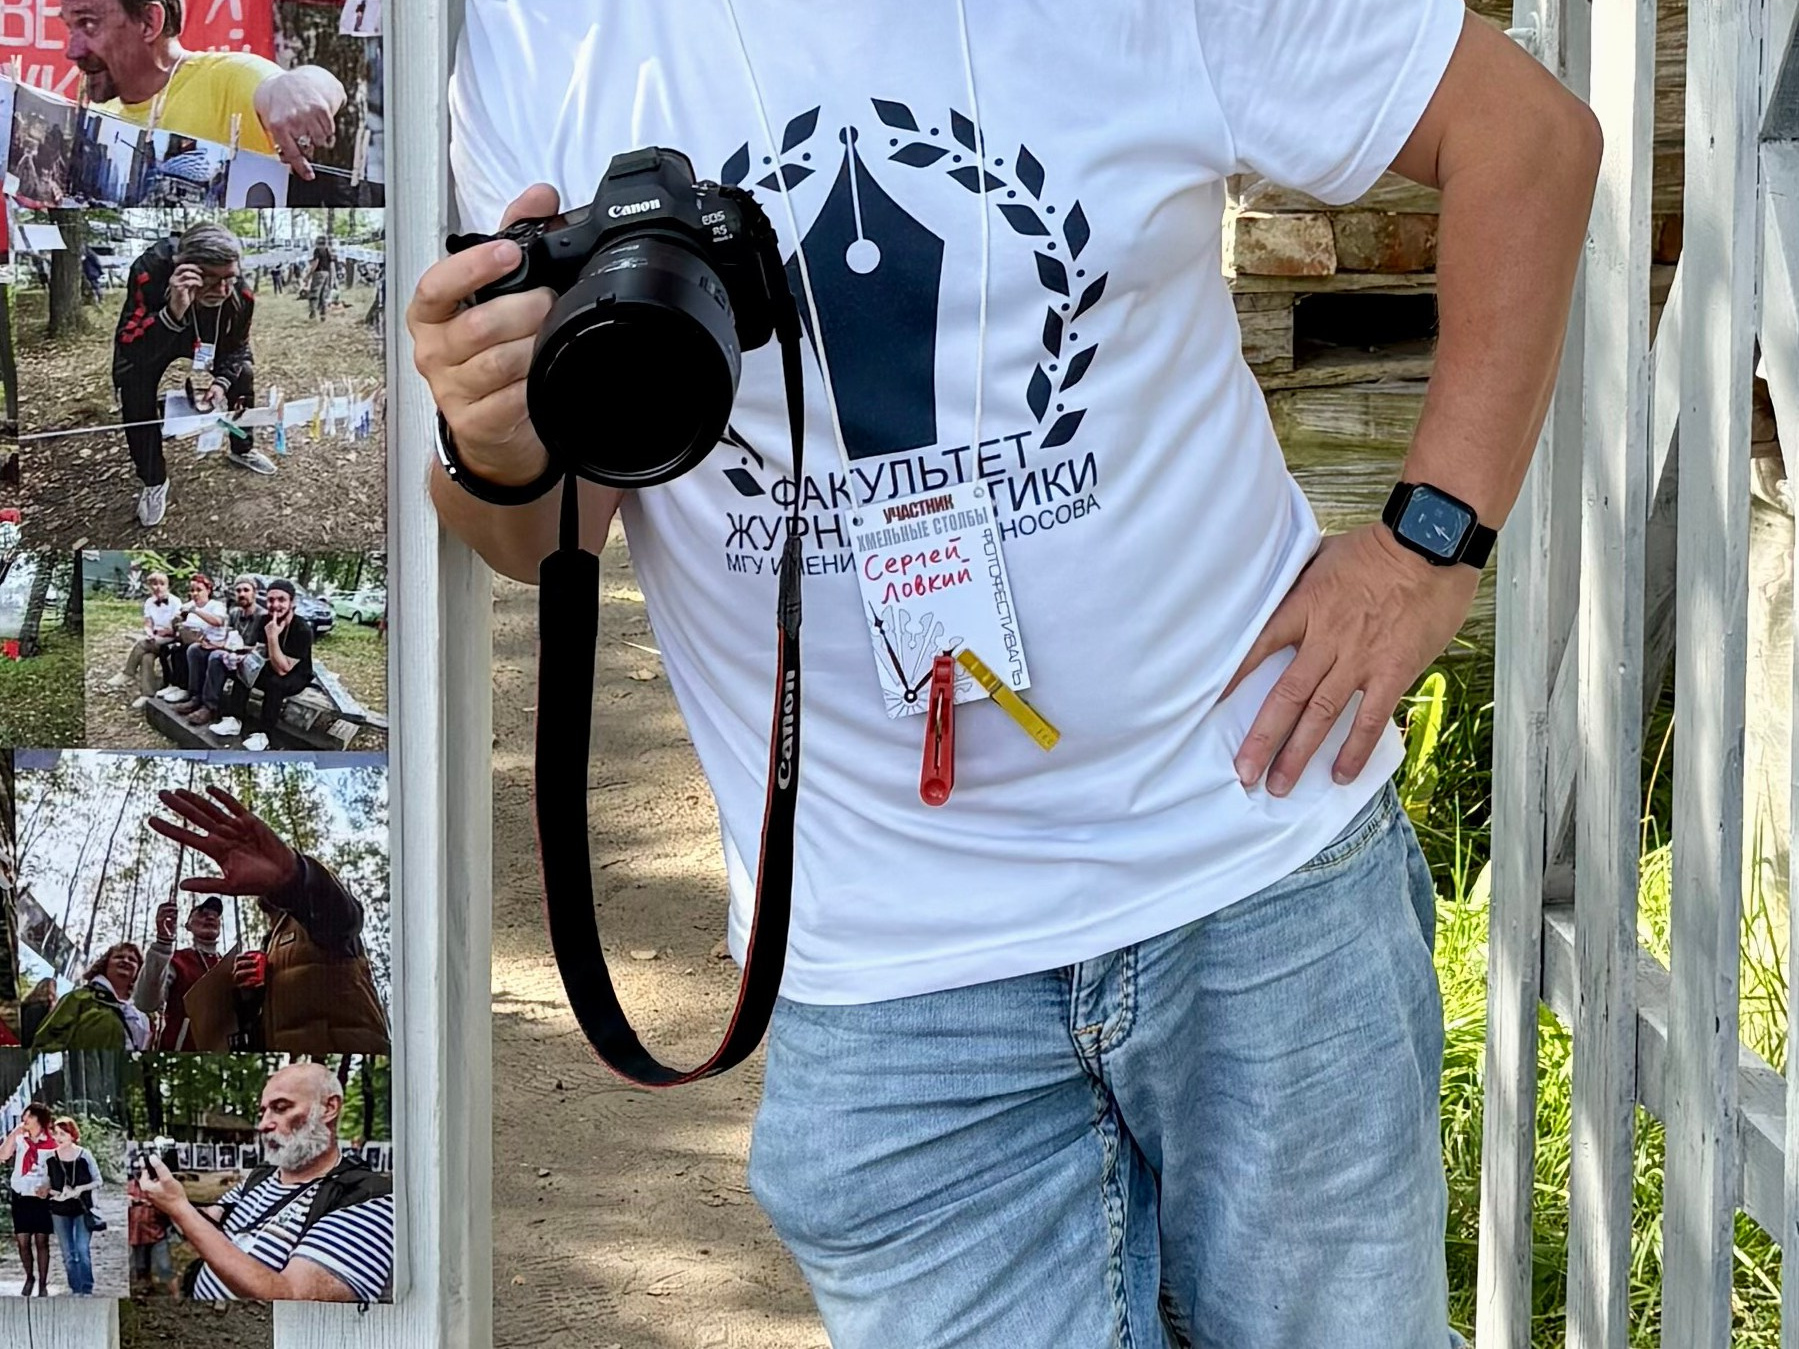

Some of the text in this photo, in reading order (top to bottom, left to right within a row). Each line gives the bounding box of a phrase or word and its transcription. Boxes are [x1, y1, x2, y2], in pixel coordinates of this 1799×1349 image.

[608, 199, 661, 218] Canon
[701, 211, 726, 226] EOS
[771, 431, 1032, 511] ФАКУЛЬТЕТ
[857, 507, 989, 553] ХМЕЛЬНЫЕ СТОЛБЫ
[883, 494, 954, 524] УЧАСТНИК
[726, 553, 763, 575] МГУ
[771, 551, 857, 576] ИЕНИ
[865, 536, 961, 581] Сергей
[982, 528, 1023, 686] ФОТОФЕСТИВАЛЬ
[778, 670, 796, 790] Canon
